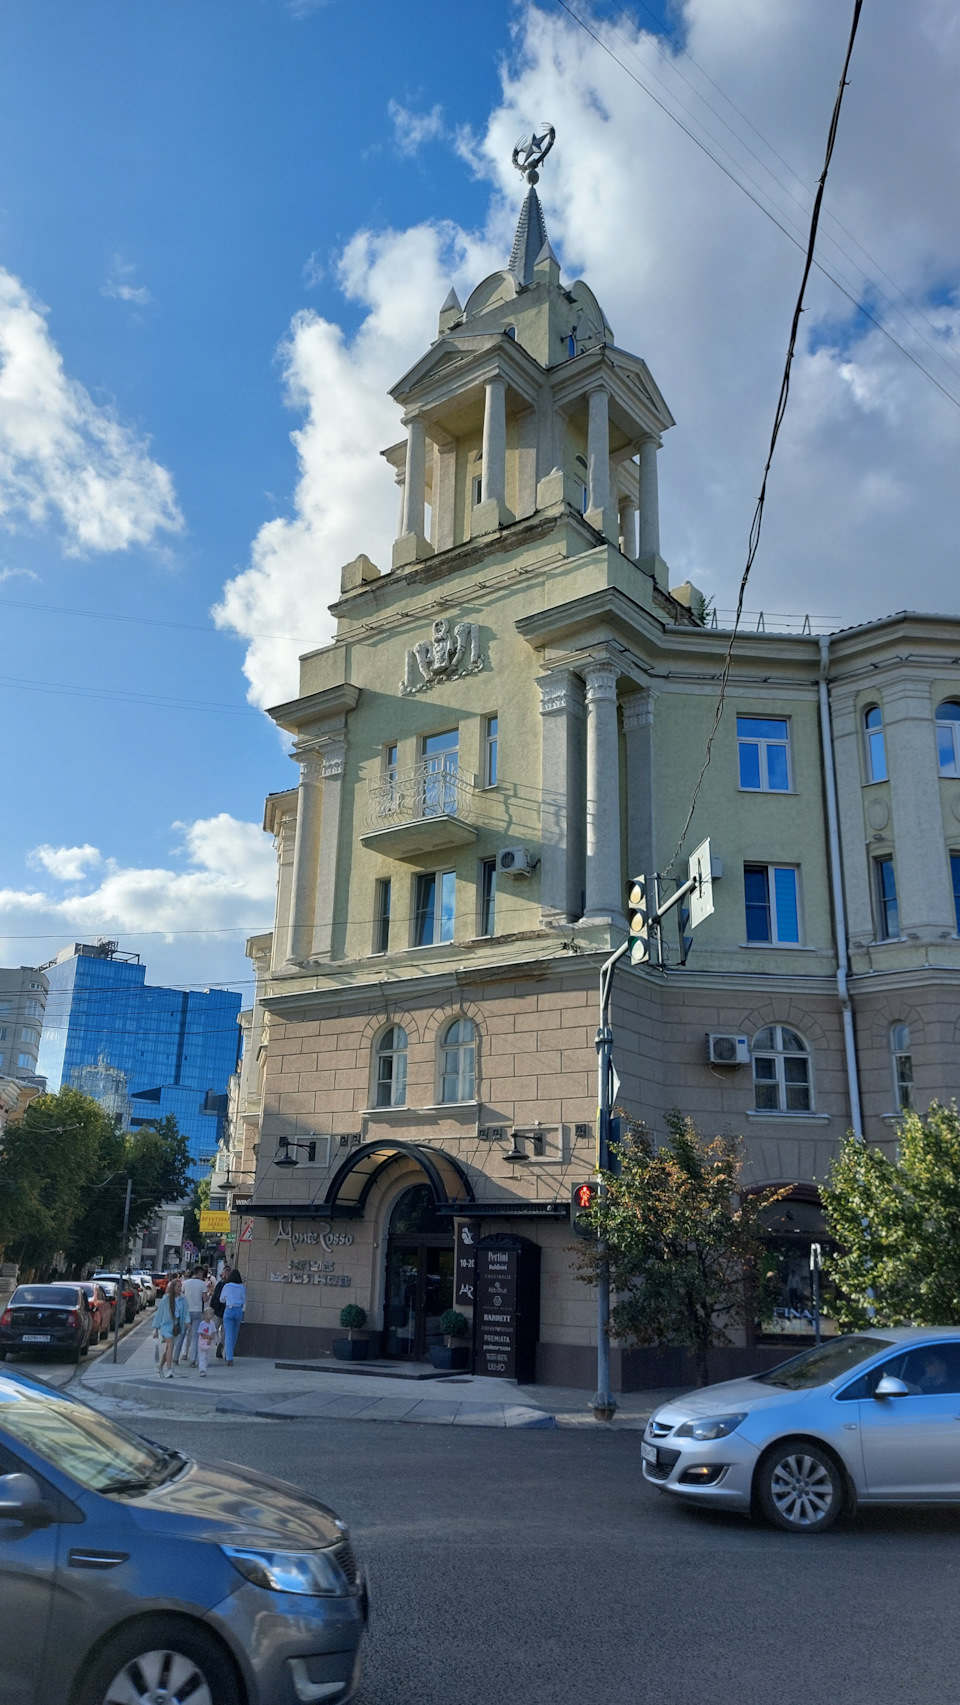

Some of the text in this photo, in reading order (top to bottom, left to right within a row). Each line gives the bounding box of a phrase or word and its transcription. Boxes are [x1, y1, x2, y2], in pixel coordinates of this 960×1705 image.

[272, 1219, 354, 1252] Monte Rosso
[773, 1306, 817, 1319] FINA
[484, 1334, 511, 1343] PREMIATA
